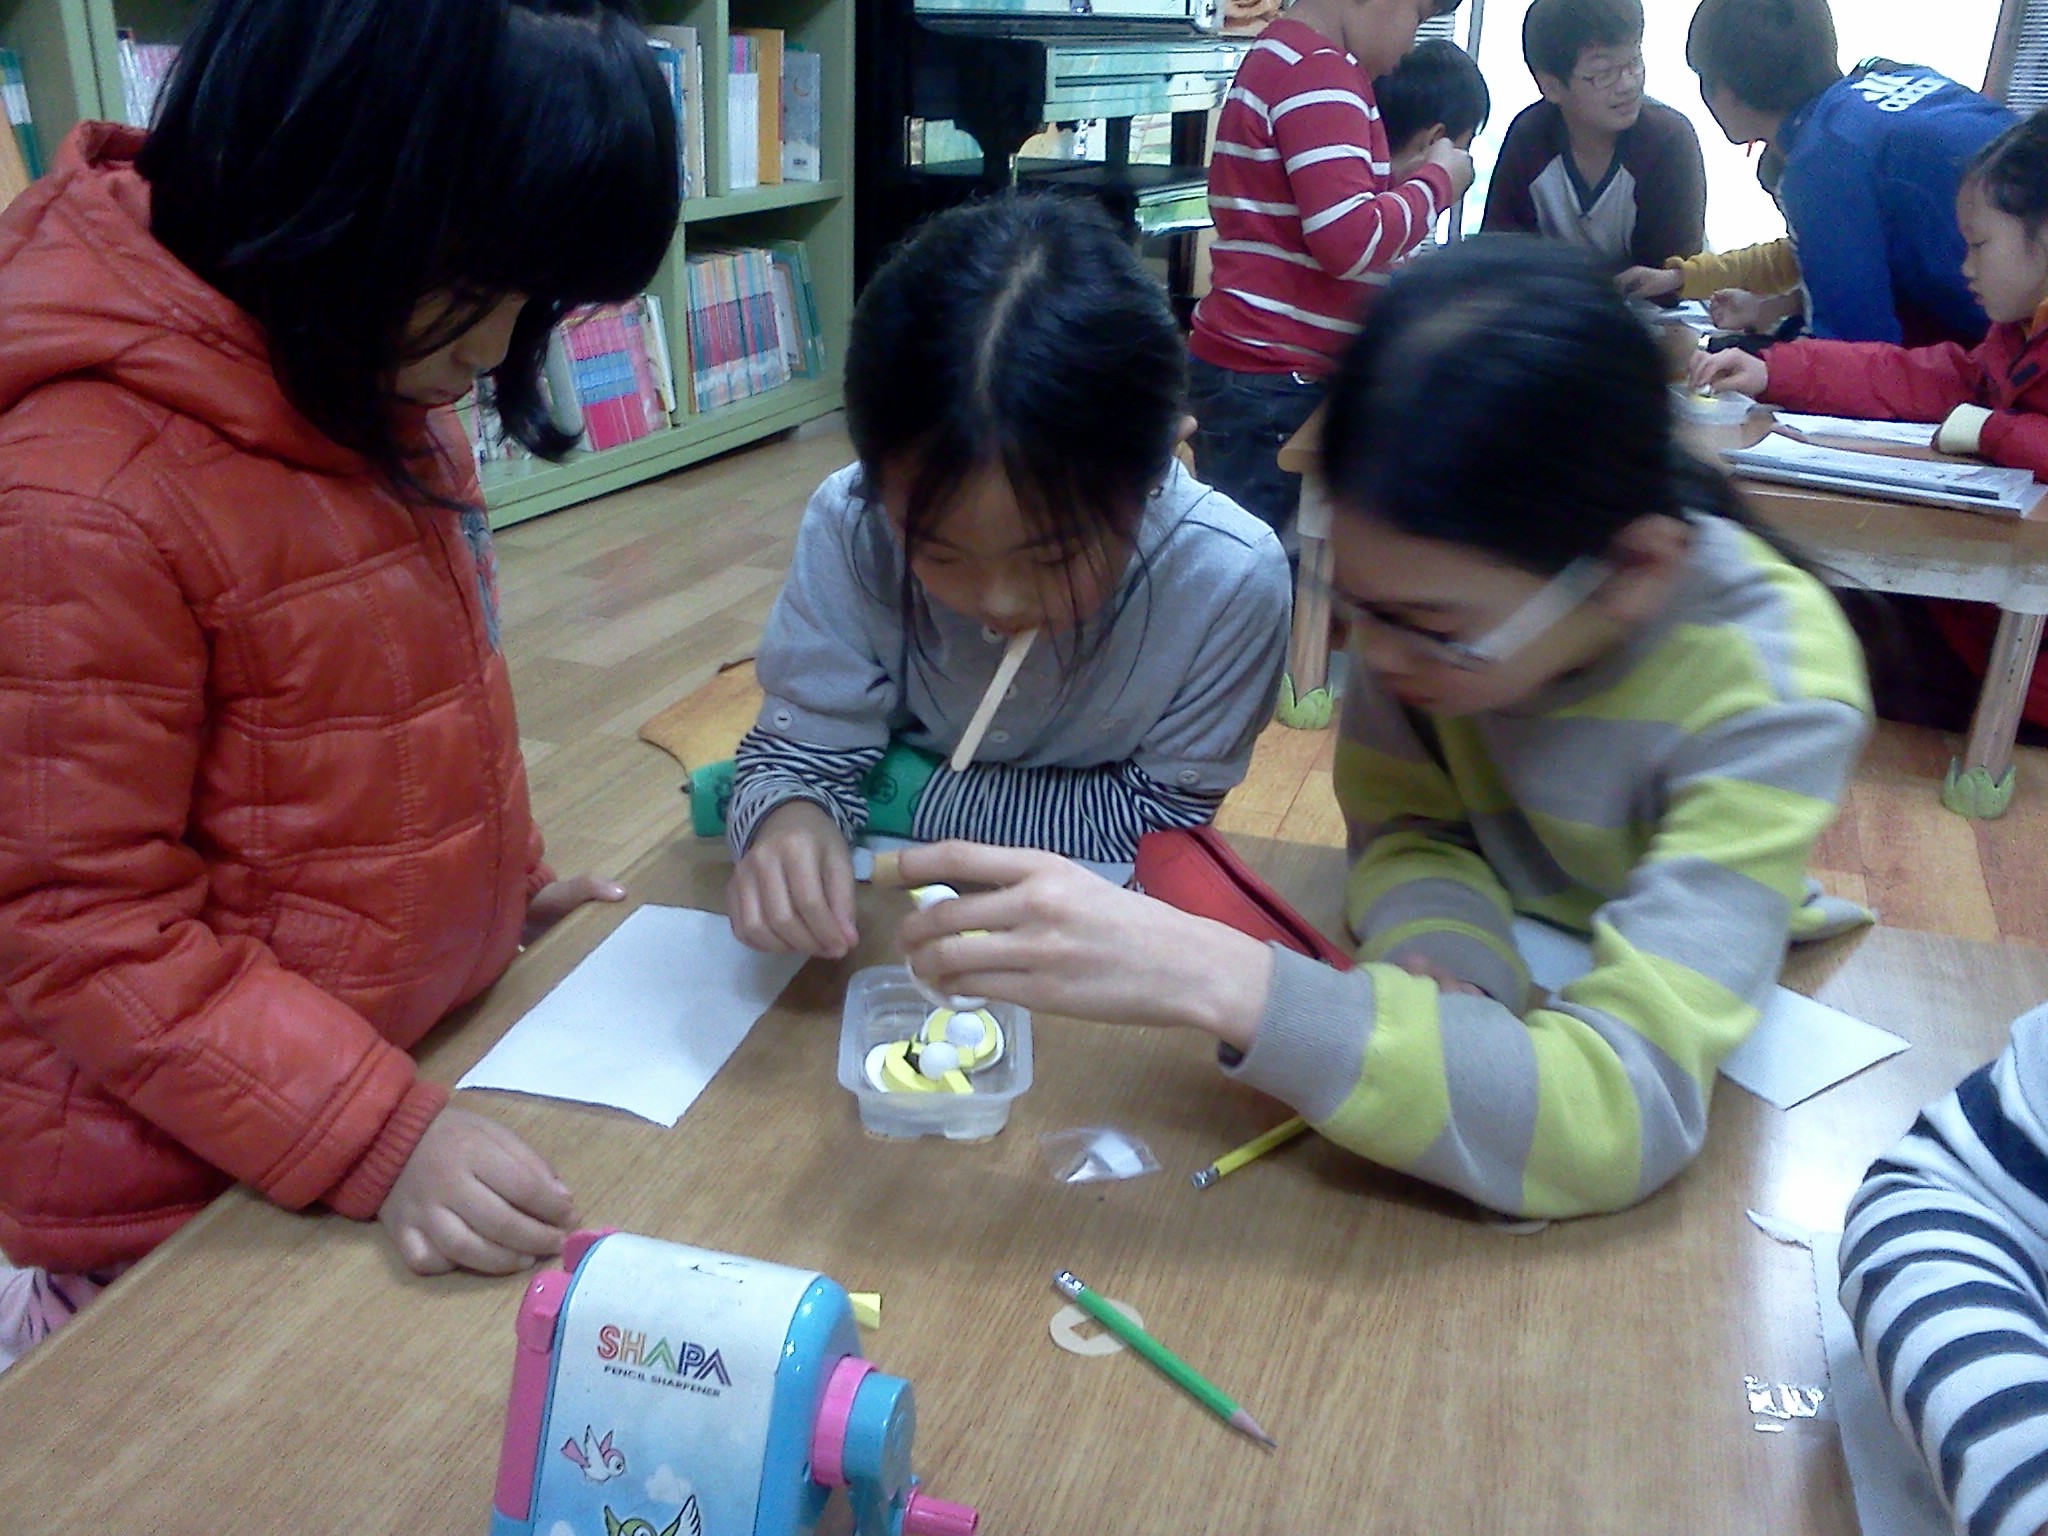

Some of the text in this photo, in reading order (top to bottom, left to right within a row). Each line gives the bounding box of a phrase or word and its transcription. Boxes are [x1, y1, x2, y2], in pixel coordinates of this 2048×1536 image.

[597, 1324, 732, 1387] SHAPA
[604, 1365, 721, 1397] PENCIL SHARPENER
